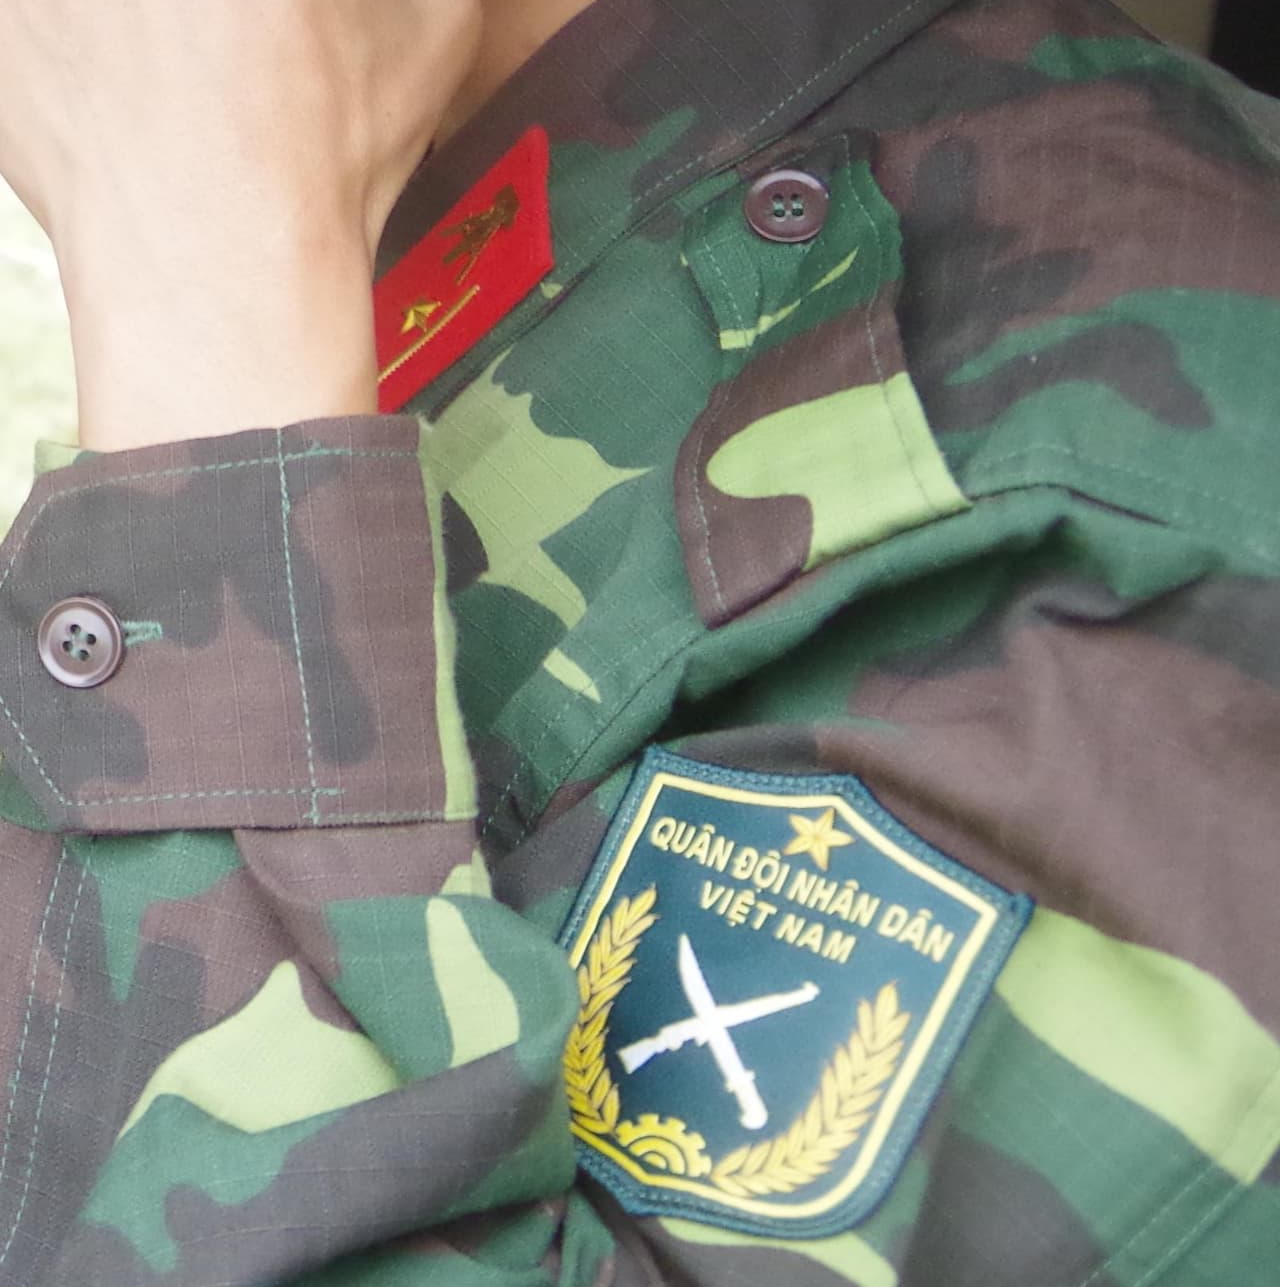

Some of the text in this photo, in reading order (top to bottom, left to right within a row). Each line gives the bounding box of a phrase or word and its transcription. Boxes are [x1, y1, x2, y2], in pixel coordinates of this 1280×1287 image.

[649, 816, 955, 963] QUÂN ĐỘI NHÂN DÂN
[700, 880, 857, 964] VIỆT NAM
